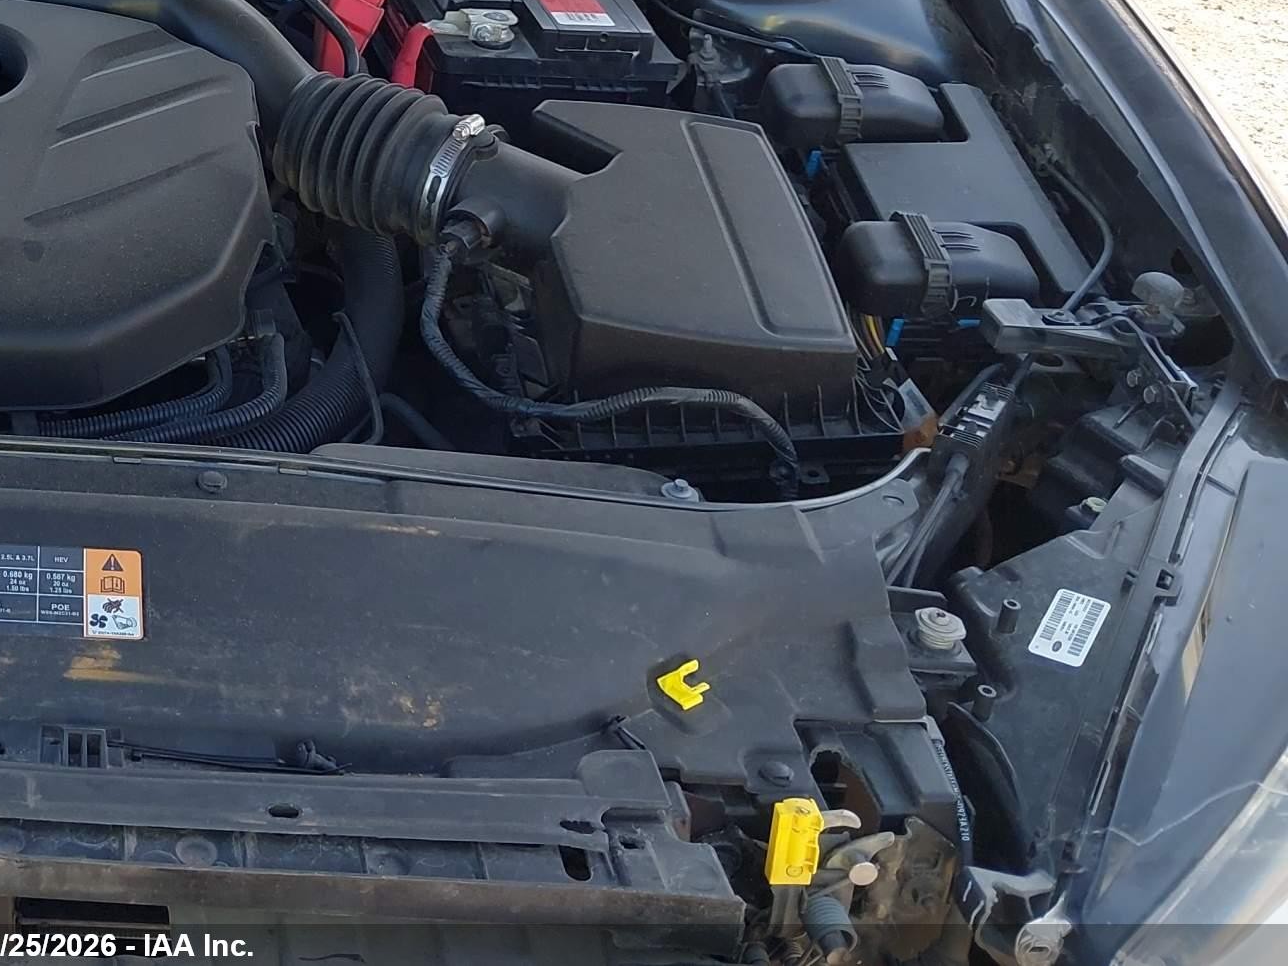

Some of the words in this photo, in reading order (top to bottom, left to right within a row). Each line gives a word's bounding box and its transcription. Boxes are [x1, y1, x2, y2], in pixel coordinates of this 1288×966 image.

[3, 570, 23, 578] 0.680
[24, 571, 33, 580] kg
[67, 574, 76, 583] kg
[51, 603, 70, 611] POE
